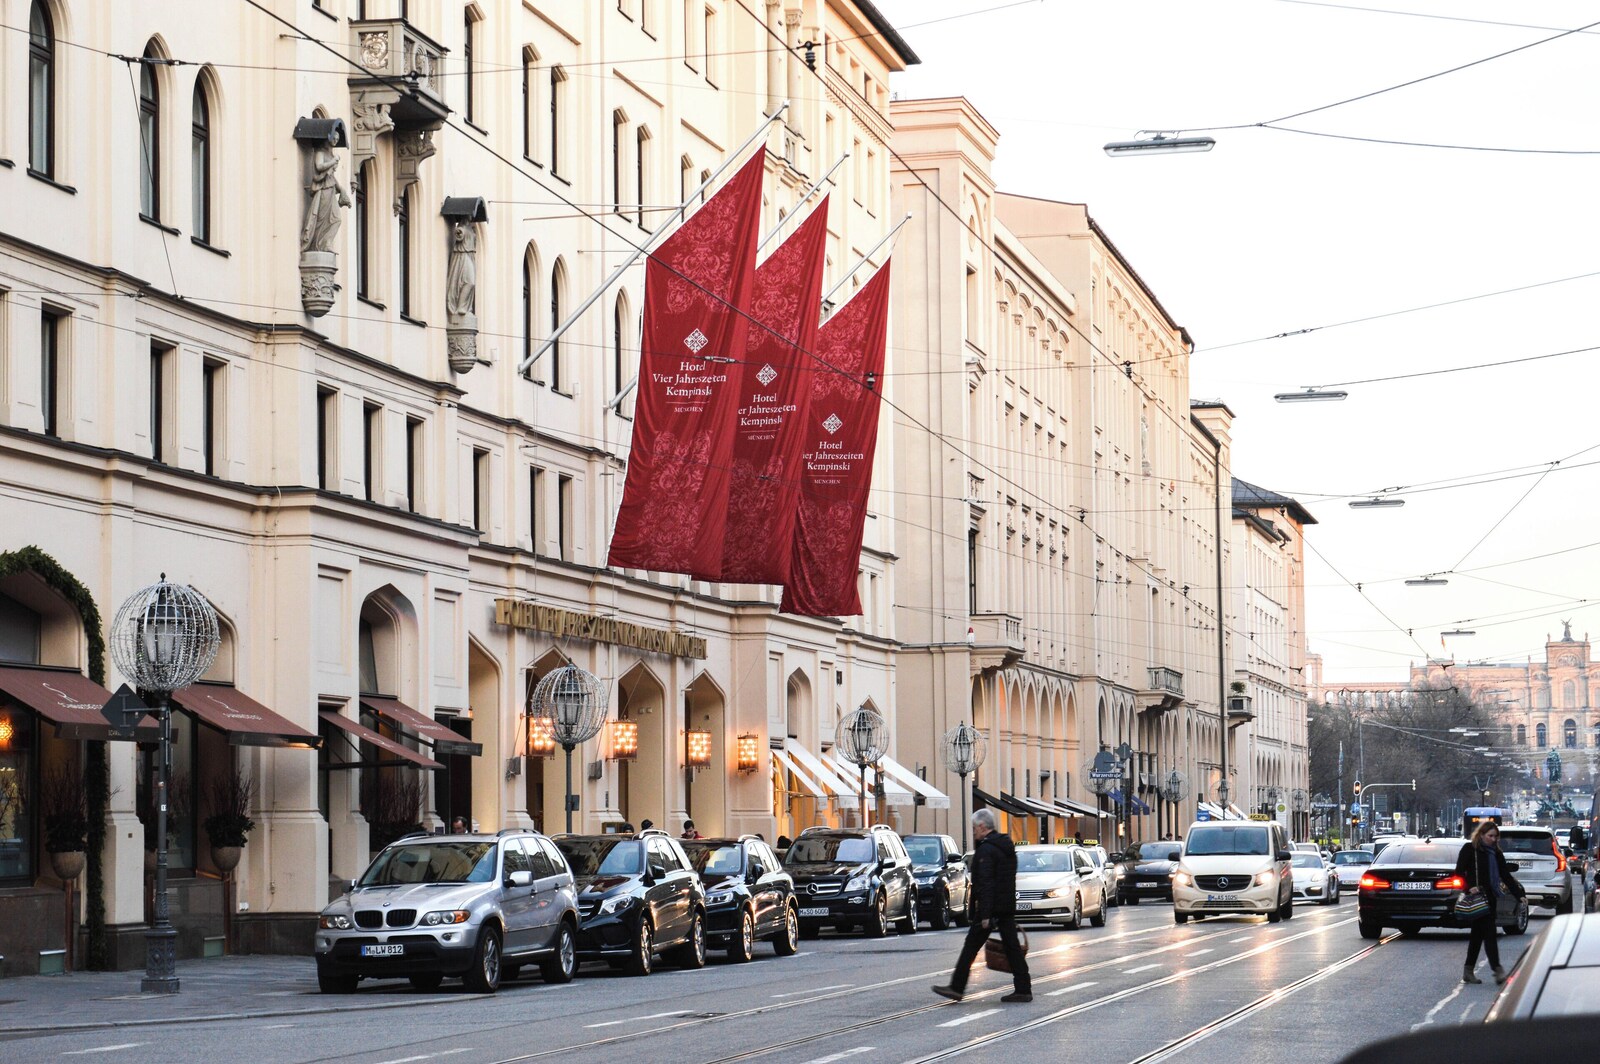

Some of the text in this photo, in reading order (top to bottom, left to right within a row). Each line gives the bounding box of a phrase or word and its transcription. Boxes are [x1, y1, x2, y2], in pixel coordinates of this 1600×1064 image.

[680, 361, 706, 371] Hotel
[653, 373, 727, 386] Vier Jahreszeten
[753, 393, 777, 403] Hotel
[748, 404, 797, 417] Jahreszeten
[819, 441, 843, 450] Hotel
[813, 451, 864, 462] Jahreszeiten
[807, 462, 851, 473] Kempinski
[387, 945, 403, 954] 812
